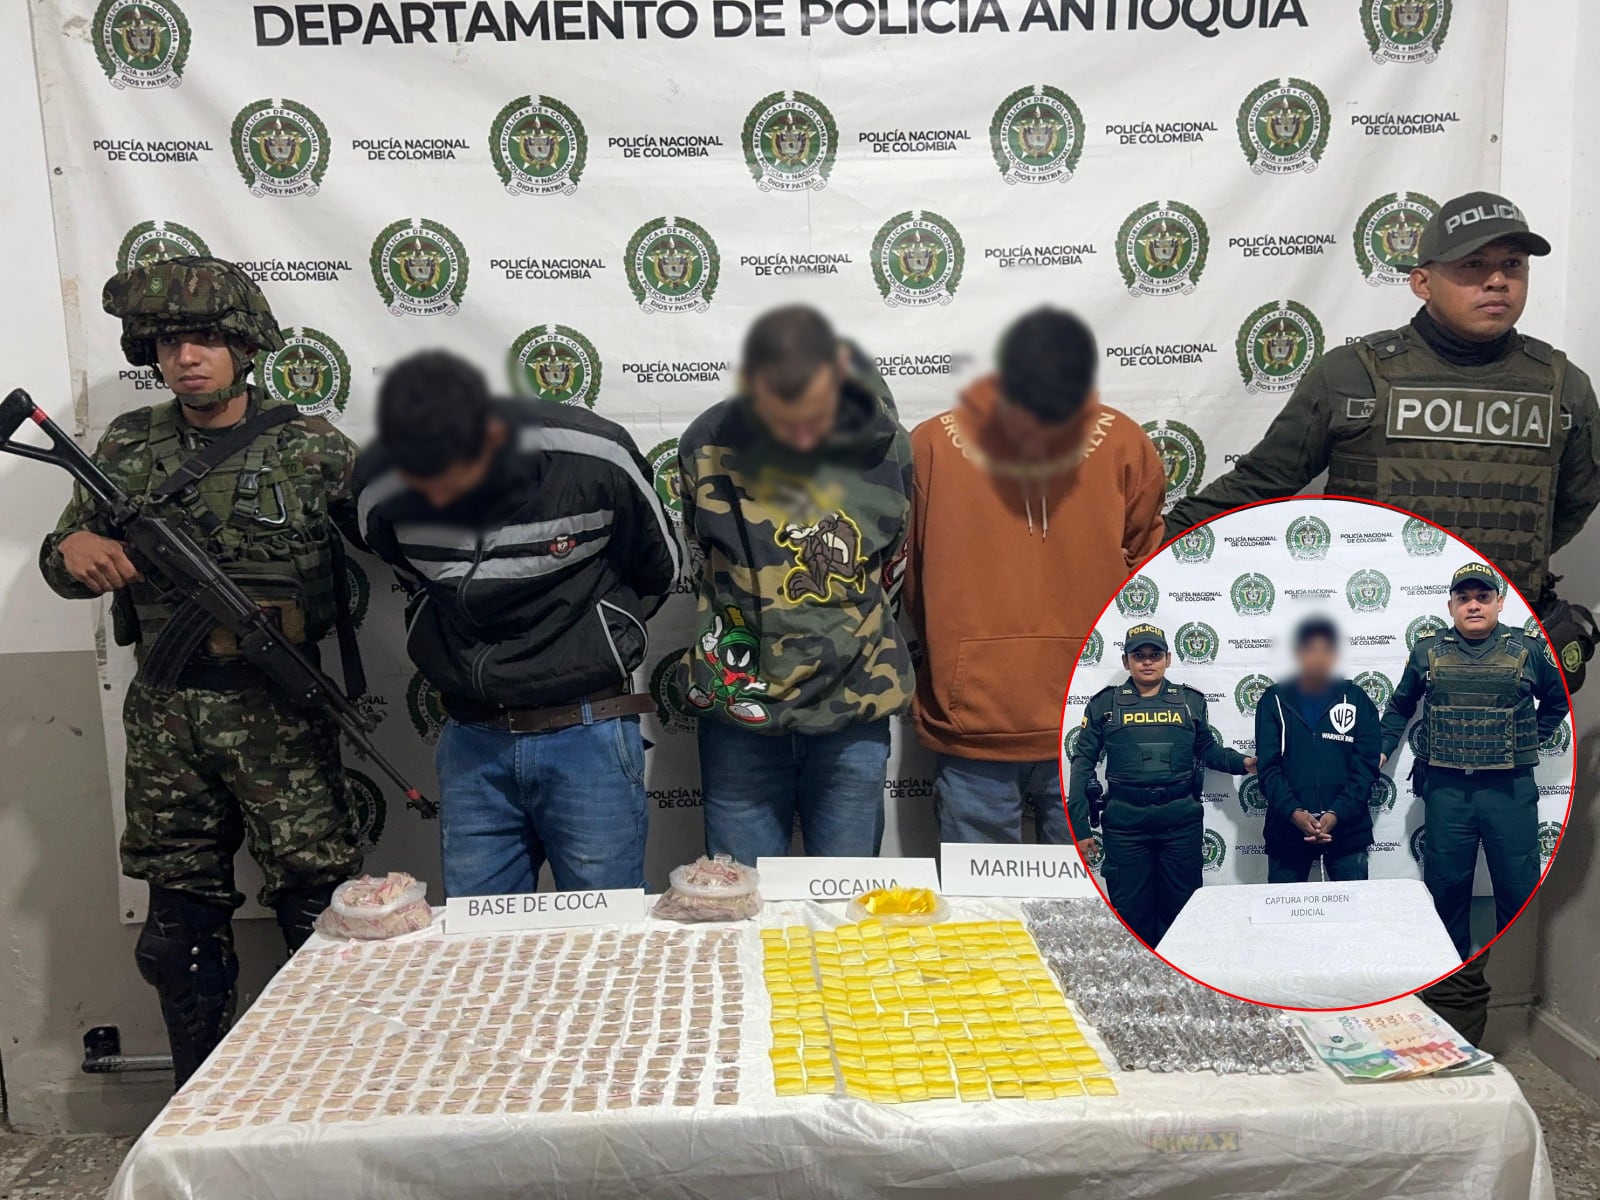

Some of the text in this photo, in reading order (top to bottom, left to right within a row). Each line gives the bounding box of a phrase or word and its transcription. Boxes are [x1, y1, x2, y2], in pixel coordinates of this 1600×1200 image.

[254, 0, 698, 46] DEPARTAMENTO
[714, 0, 785, 37] DE
[1018, 0, 1308, 38] ANTIOQUIA
[1299, 92, 1320, 129] COLOMBIA
[1352, 112, 1460, 125] POLICÍA NACIONAL
[293, 114, 318, 152] COLOMBIA
[552, 112, 576, 150] COLOMBIA
[1106, 122, 1218, 134] POLICÍA NACIONAL
[1365, 123, 1445, 135] DE COLOMBIA
[608, 134, 723, 148] POLICÍA NACIONAL
[859, 129, 971, 142] POLICÍA NACIONAL
[1120, 133, 1203, 144] DE COLOMBIA
[93, 139, 213, 151] POLICÍA NACIONAL
[352, 137, 470, 150] POLICÍA NACIONAL
[873, 141, 956, 153] DE COLOMBIA
[1284, 138, 1315, 161] NACIONAL
[108, 151, 198, 162] DE COLOMBIA
[368, 150, 456, 160] DE COLOMBIA
[624, 147, 709, 158] DE COLOMBIA
[1284, 159, 1307, 171] PATRIA
[284, 161, 314, 184] NACIONAL
[541, 160, 572, 183] NACIONAL
[285, 183, 308, 194] PATRIA
[542, 182, 566, 193] PATRIA
[1229, 234, 1336, 248] POLICÍA NACIONAL
[432, 234, 457, 272] COLOMBIA
[985, 244, 1096, 258] POLICÍA NACIONAL
[1243, 245, 1324, 257] DE COLOMBIA
[490, 257, 606, 269] POLICÍA NACIONAL
[741, 253, 852, 266] POLICÍA NACIONAL
[1000, 258, 1015, 267] DE
[287, 261, 352, 271] NACIONAL
[755, 264, 838, 276] DE COLOMBIA
[251, 271, 339, 282] DE COLOMBIA
[506, 269, 591, 279] DE COLOMBIA
[423, 281, 454, 304] NACIONAL
[424, 302, 448, 314] PATRIA
[1107, 343, 1217, 357] POLICÍA NACIONAL
[874, 354, 912, 367] OLICÍA
[1120, 354, 1203, 366] DE COLOMBIA
[622, 361, 670, 373] POLICÍA
[880, 366, 896, 376] DE
[119, 370, 156, 380] POLIC
[637, 372, 720, 383] DE COLOMBIA
[135, 380, 153, 390] DE
[1396, 397, 1544, 438] POLICÍA
[1123, 710, 1183, 724] POLICÍA
[884, 778, 927, 790] OLICÍA
[890, 789, 906, 798] DE
[659, 799, 676, 808] DE
[469, 892, 608, 917] BASE DE COCA
[1265, 894, 1350, 905] CAPTURA POR ORDEN
[1290, 908, 1325, 917] JUDICIAL
